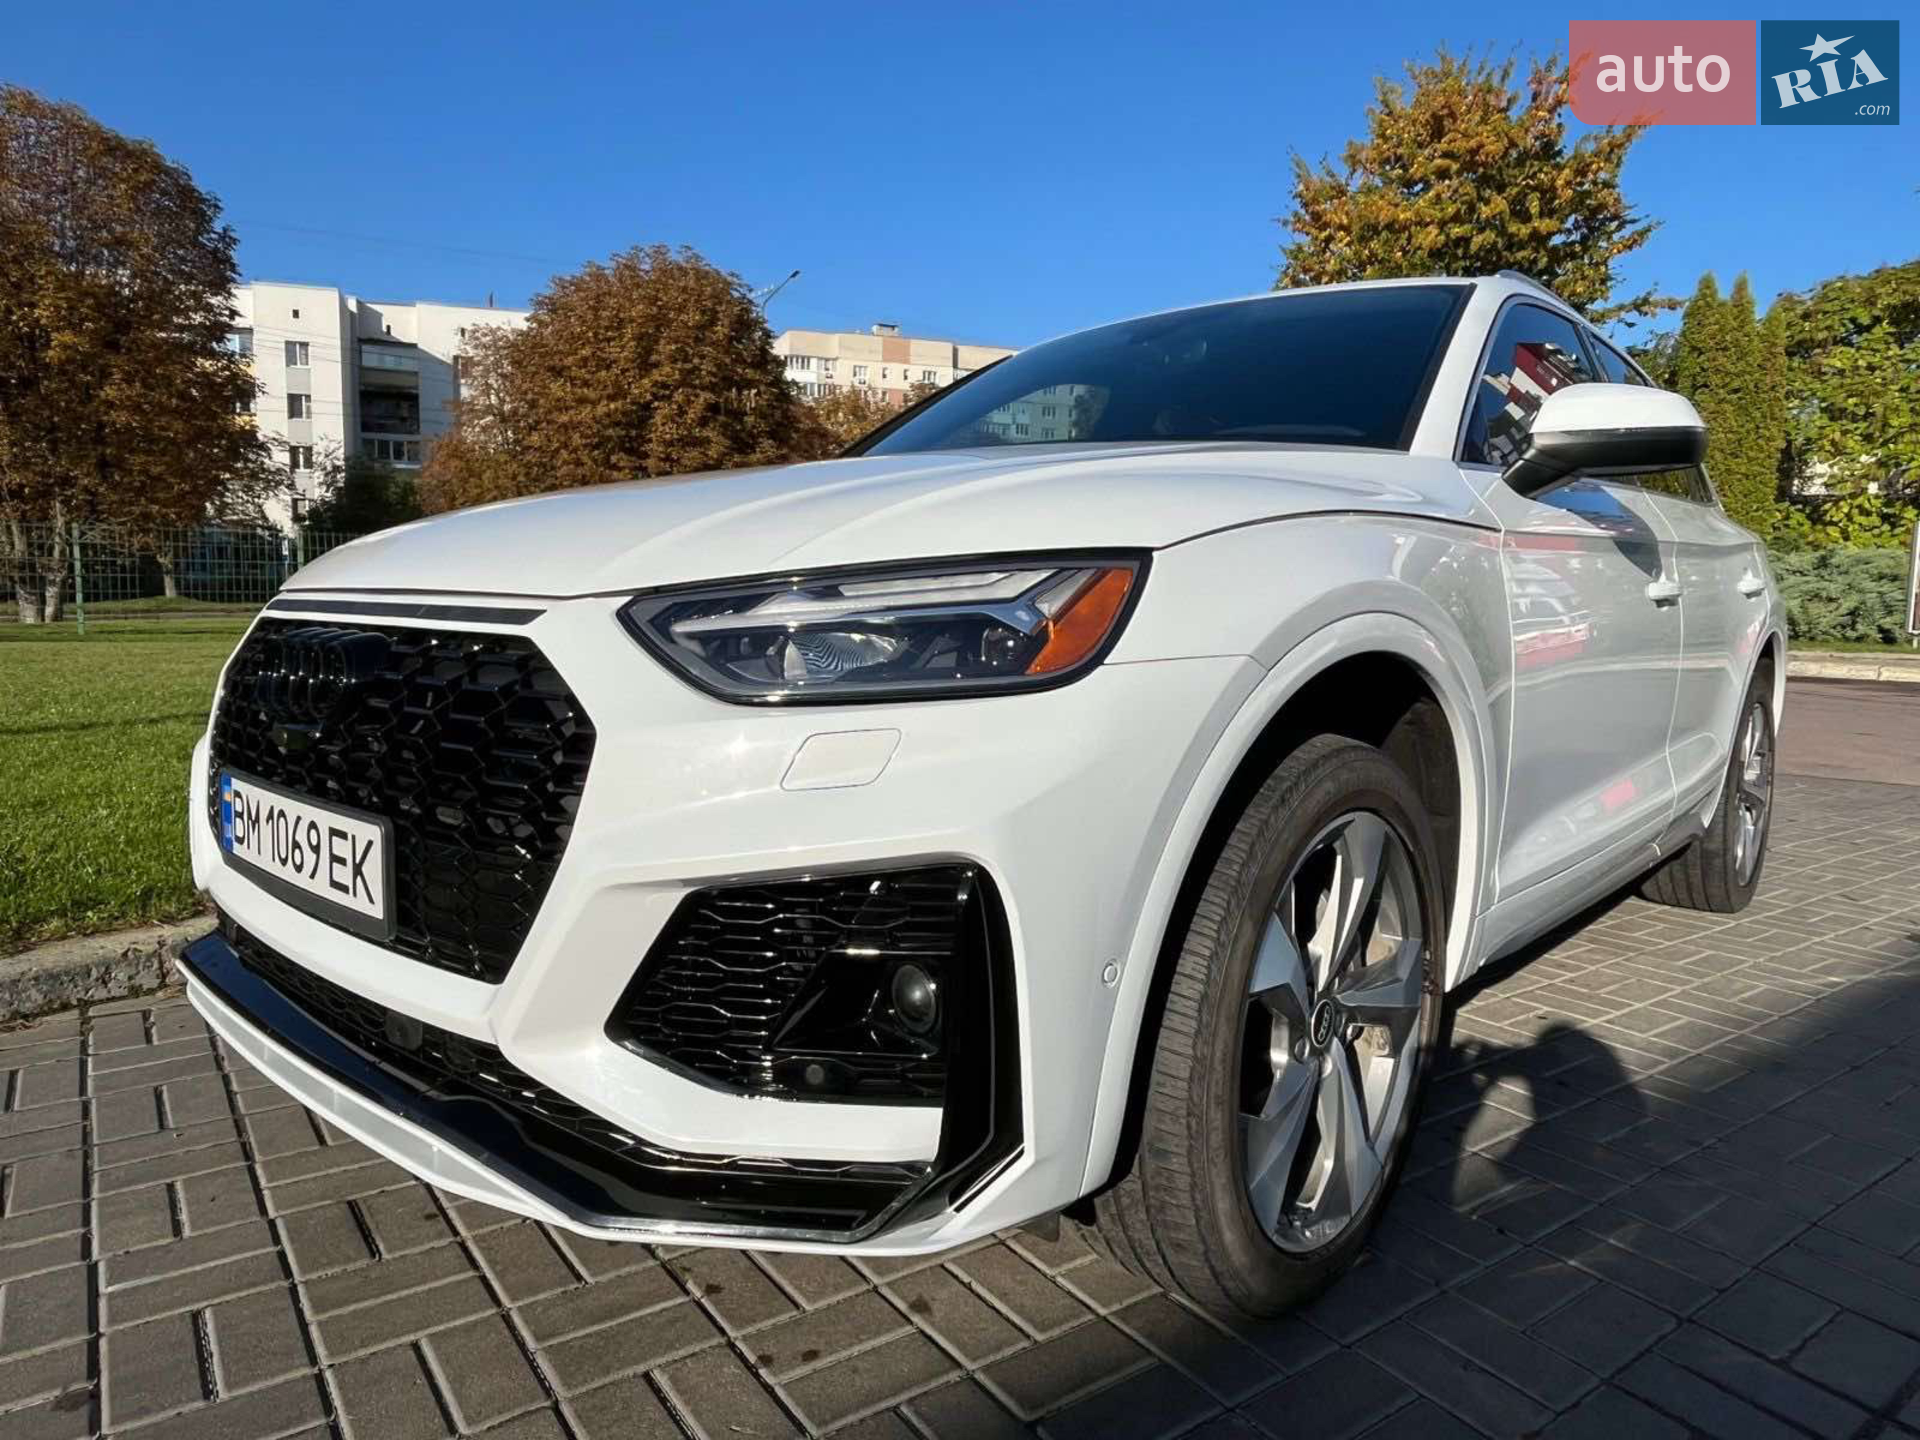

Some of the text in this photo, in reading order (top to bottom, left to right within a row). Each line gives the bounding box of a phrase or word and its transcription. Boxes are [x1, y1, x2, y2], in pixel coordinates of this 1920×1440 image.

[233, 789, 375, 905] BM 1069 EK
